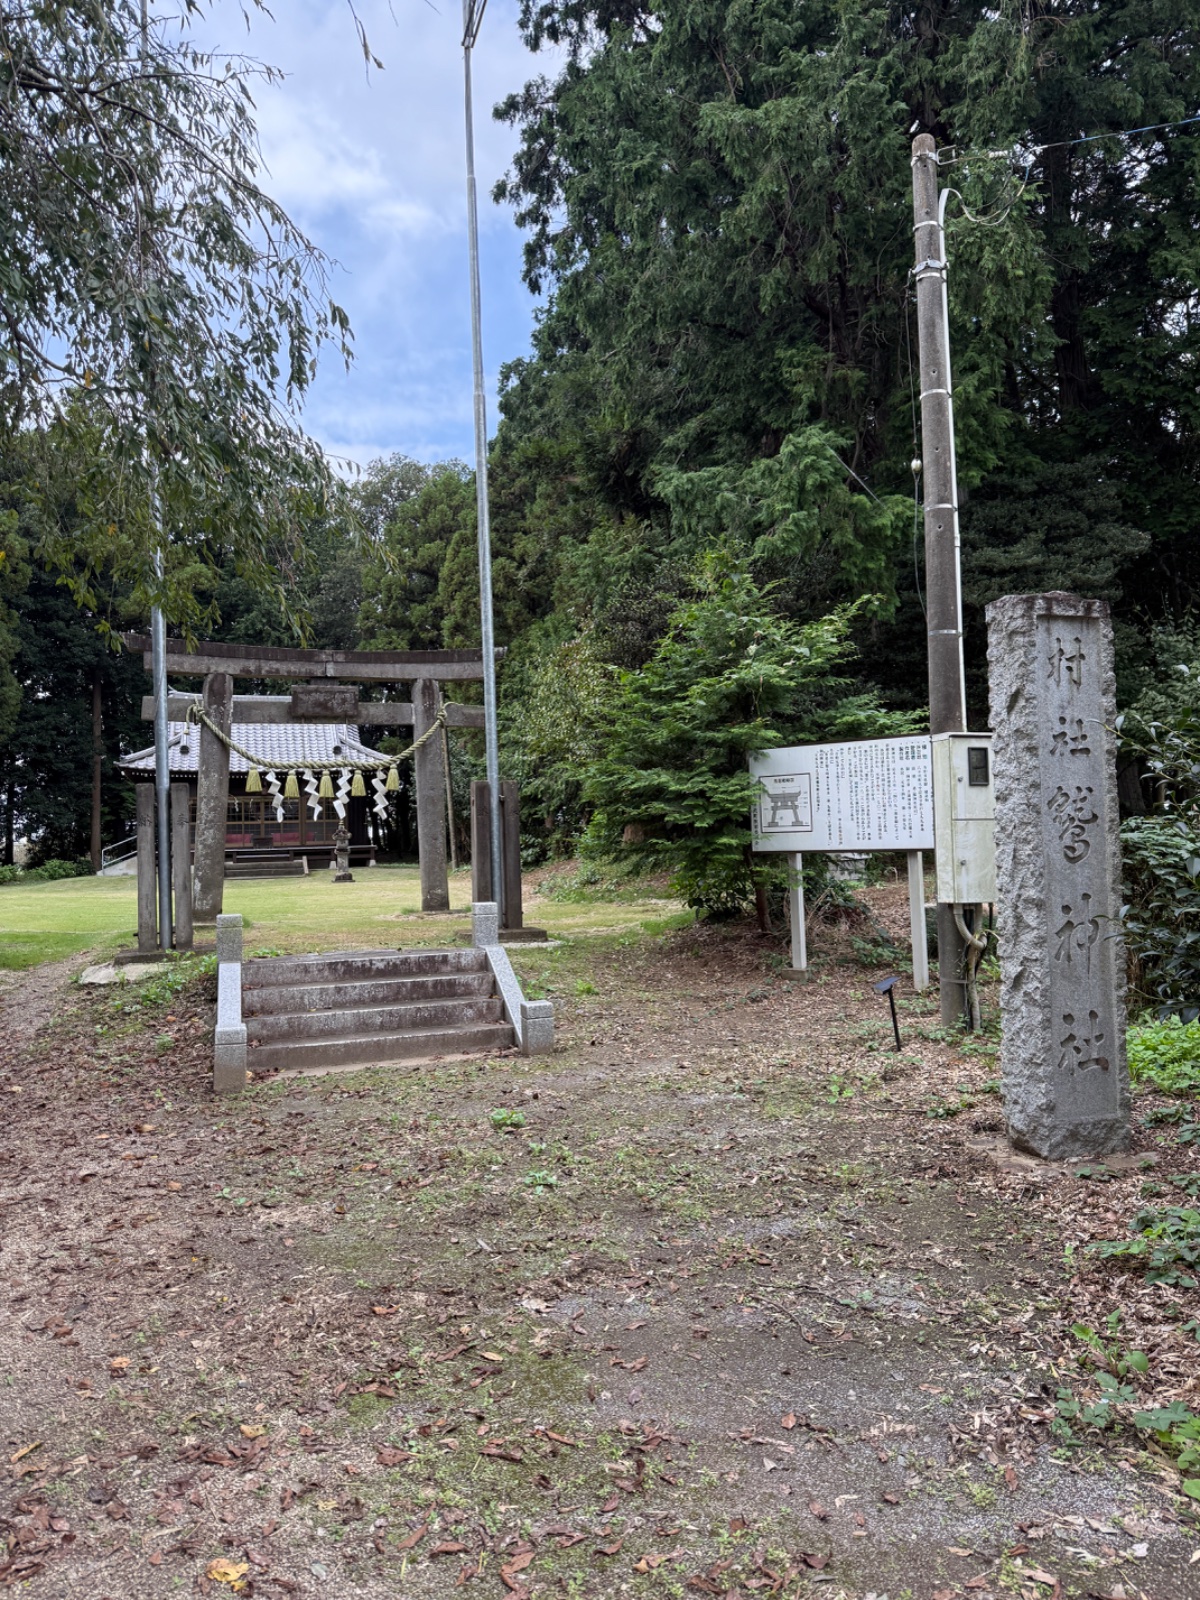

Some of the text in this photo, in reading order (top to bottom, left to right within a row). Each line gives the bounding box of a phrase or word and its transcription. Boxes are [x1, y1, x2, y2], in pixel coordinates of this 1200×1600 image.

[1047, 636, 1109, 1076] 村社鷲神社
